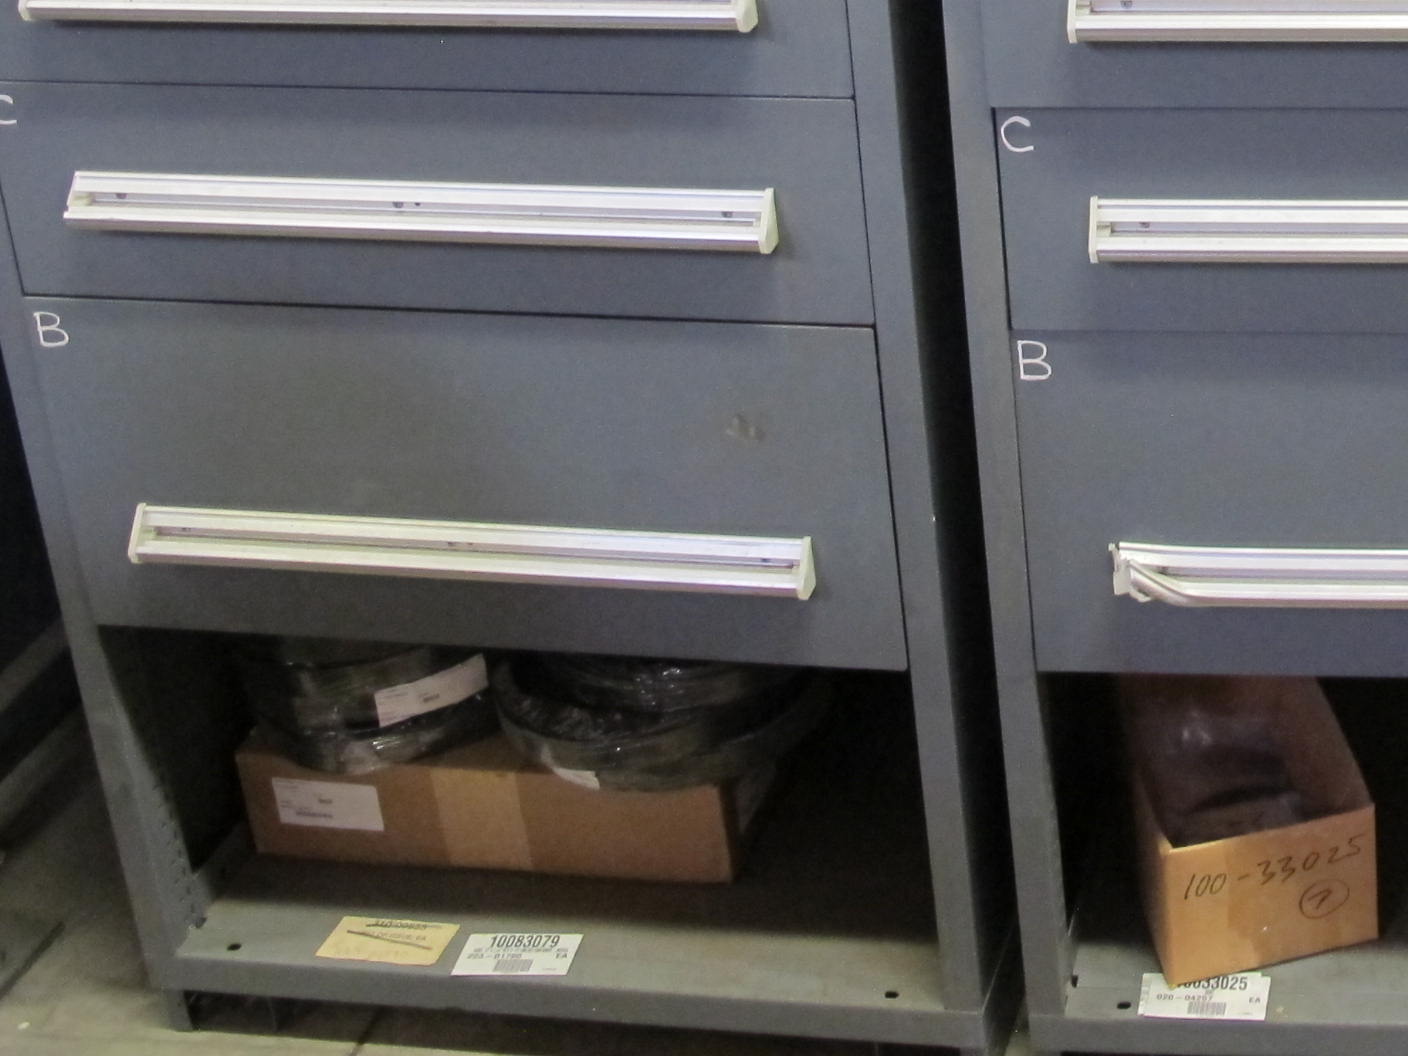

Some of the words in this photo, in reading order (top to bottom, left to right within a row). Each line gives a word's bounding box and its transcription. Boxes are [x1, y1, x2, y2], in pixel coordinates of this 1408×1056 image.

[1000, 115, 1035, 153] C
[32, 311, 70, 348] B
[1016, 339, 1053, 382] B
[488, 934, 561, 948] 10083079
